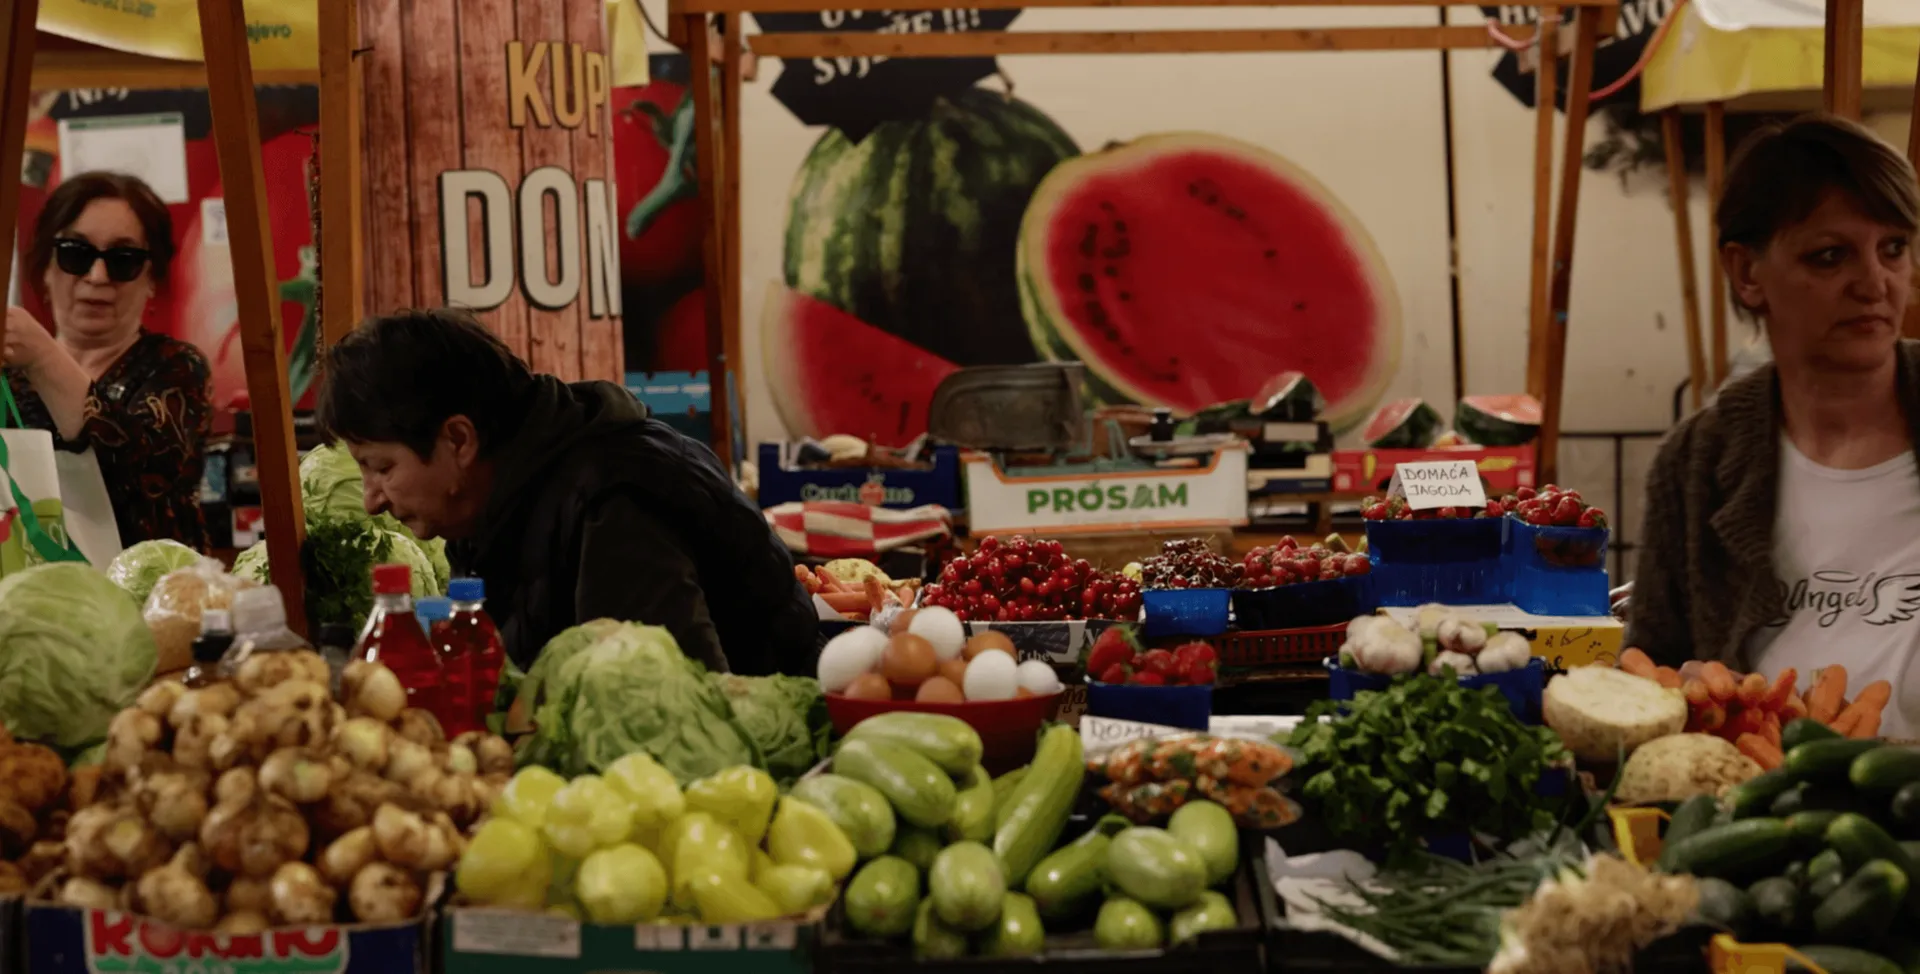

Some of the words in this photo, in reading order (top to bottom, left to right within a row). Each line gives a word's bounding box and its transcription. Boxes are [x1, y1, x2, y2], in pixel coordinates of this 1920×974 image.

[506, 41, 609, 137] KUP
[1404, 463, 1469, 481] DOMAĆA
[1407, 483, 1472, 497] JAGODA
